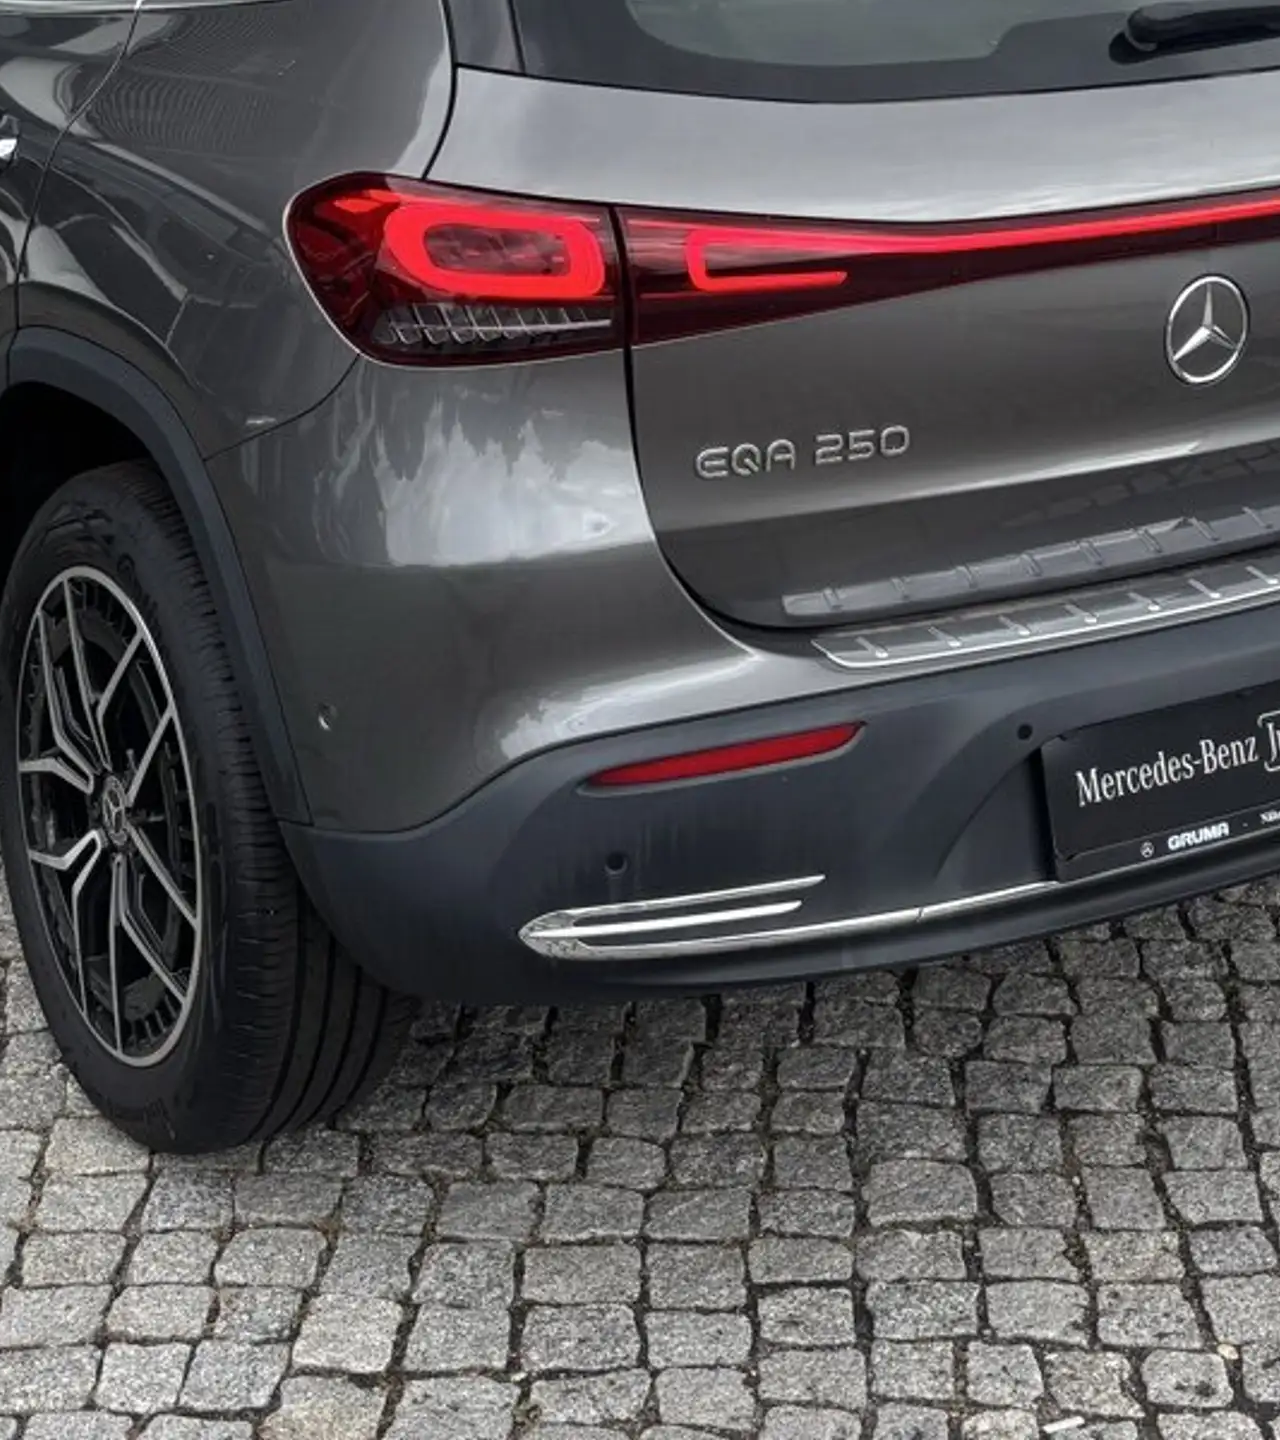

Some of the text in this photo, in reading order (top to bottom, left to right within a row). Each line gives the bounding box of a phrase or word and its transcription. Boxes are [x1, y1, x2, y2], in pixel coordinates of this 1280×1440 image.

[695, 425, 911, 479] EQA 250
[1075, 736, 1259, 807] Mercedes-Benz
[1167, 821, 1230, 851] GRUMA
